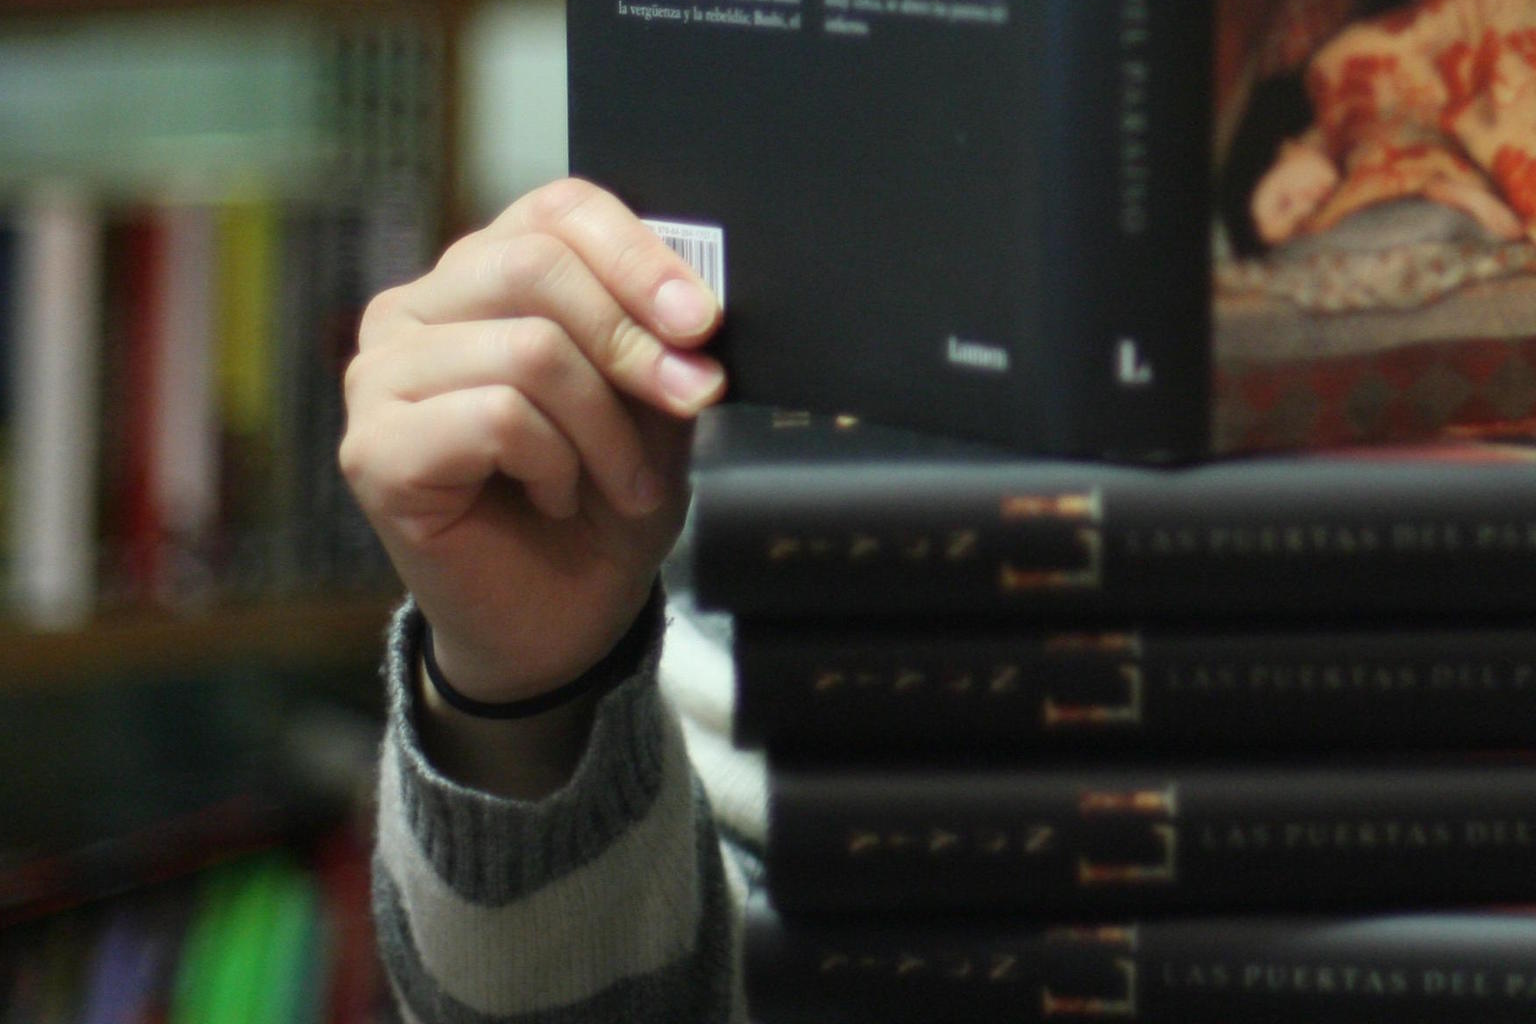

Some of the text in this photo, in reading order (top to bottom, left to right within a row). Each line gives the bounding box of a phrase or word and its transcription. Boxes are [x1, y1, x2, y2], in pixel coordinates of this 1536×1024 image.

[618, 0, 627, 15] la
[630, 5, 681, 20] vergüenza
[683, 9, 689, 23] y
